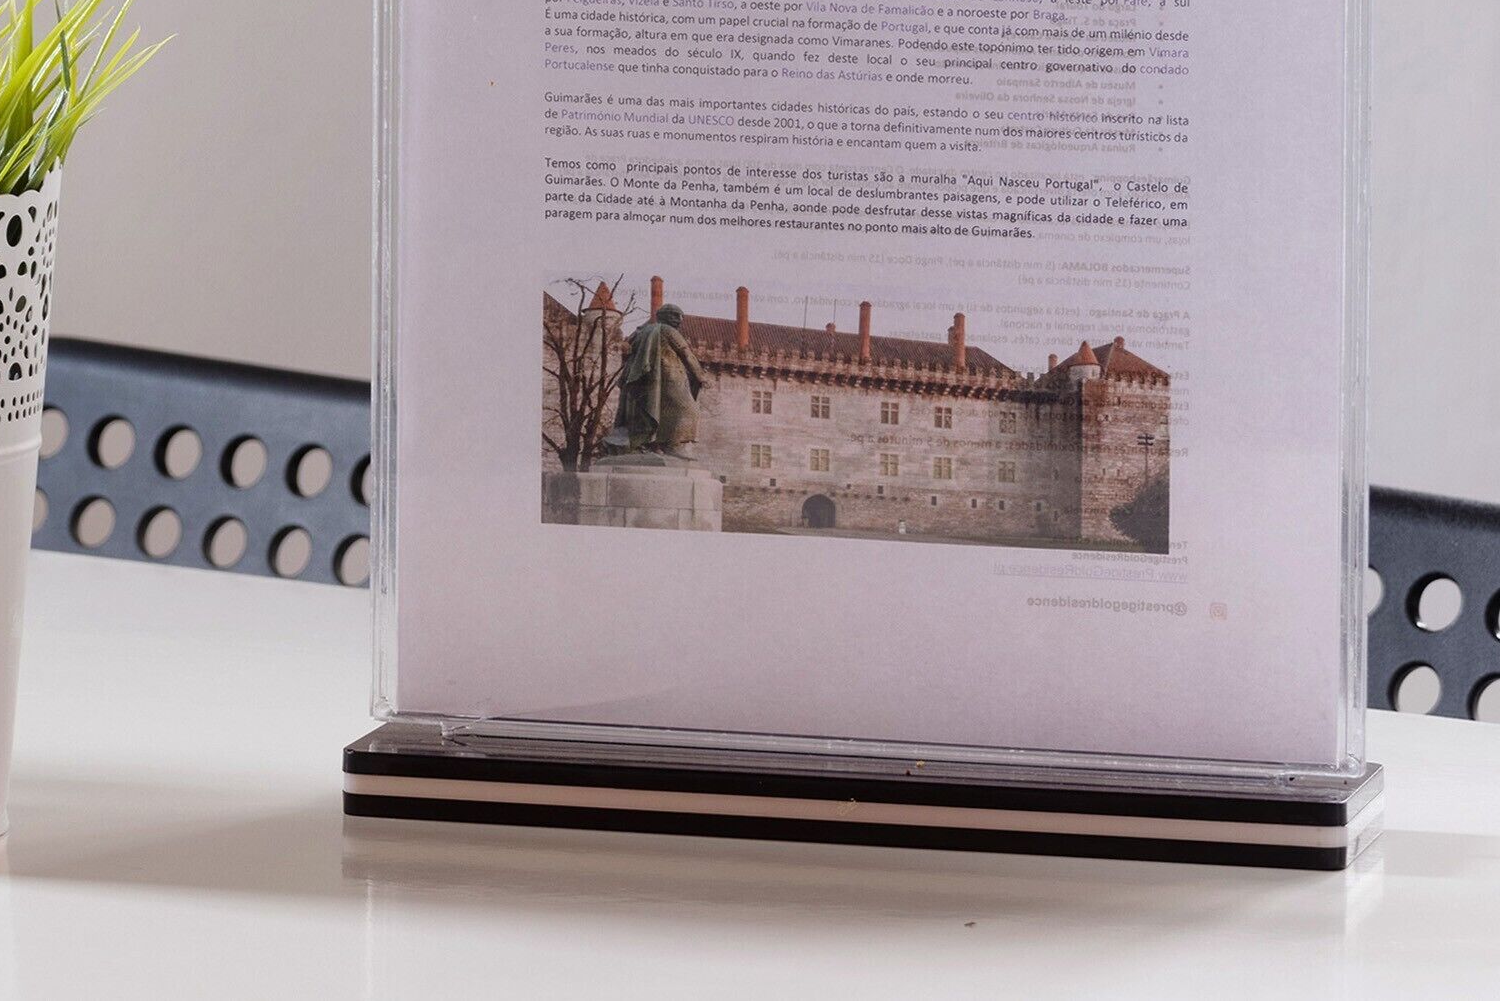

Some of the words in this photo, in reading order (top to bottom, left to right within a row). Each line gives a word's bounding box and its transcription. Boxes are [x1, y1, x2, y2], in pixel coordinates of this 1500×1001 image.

[544, 174, 605, 186] Guimarães.
[610, 177, 618, 187] O
[624, 178, 659, 188] Monte
[663, 179, 676, 189] da
[682, 181, 719, 193] Penha,
[723, 182, 769, 193] também
[774, 184, 780, 194] é
[785, 187, 802, 195] um
[808, 185, 832, 196] local
[837, 186, 851, 197] de
[855, 187, 938, 200] deslumbrantes
[943, 191, 1001, 204] paisagens,
[1005, 195, 1011, 203] e
[1017, 194, 1045, 205] pode
[1050, 195, 1088, 206] utilizar
[1104, 197, 1165, 210] Teleférico,
[1170, 201, 1187, 209] em
[545, 209, 592, 220] paragem
[596, 212, 619, 221] para
[623, 211, 666, 224] almoçar
[670, 215, 693, 223] num
[697, 214, 716, 224] dos
[720, 216, 771, 227] melhores
[775, 219, 844, 230] restaurantes
[848, 223, 862, 231] no
[865, 223, 898, 233] ponto
[902, 223, 927, 233] mais
[929, 224, 951, 234] alto
[954, 225, 968, 235] de
[971, 226, 1034, 238] Guimarães.
